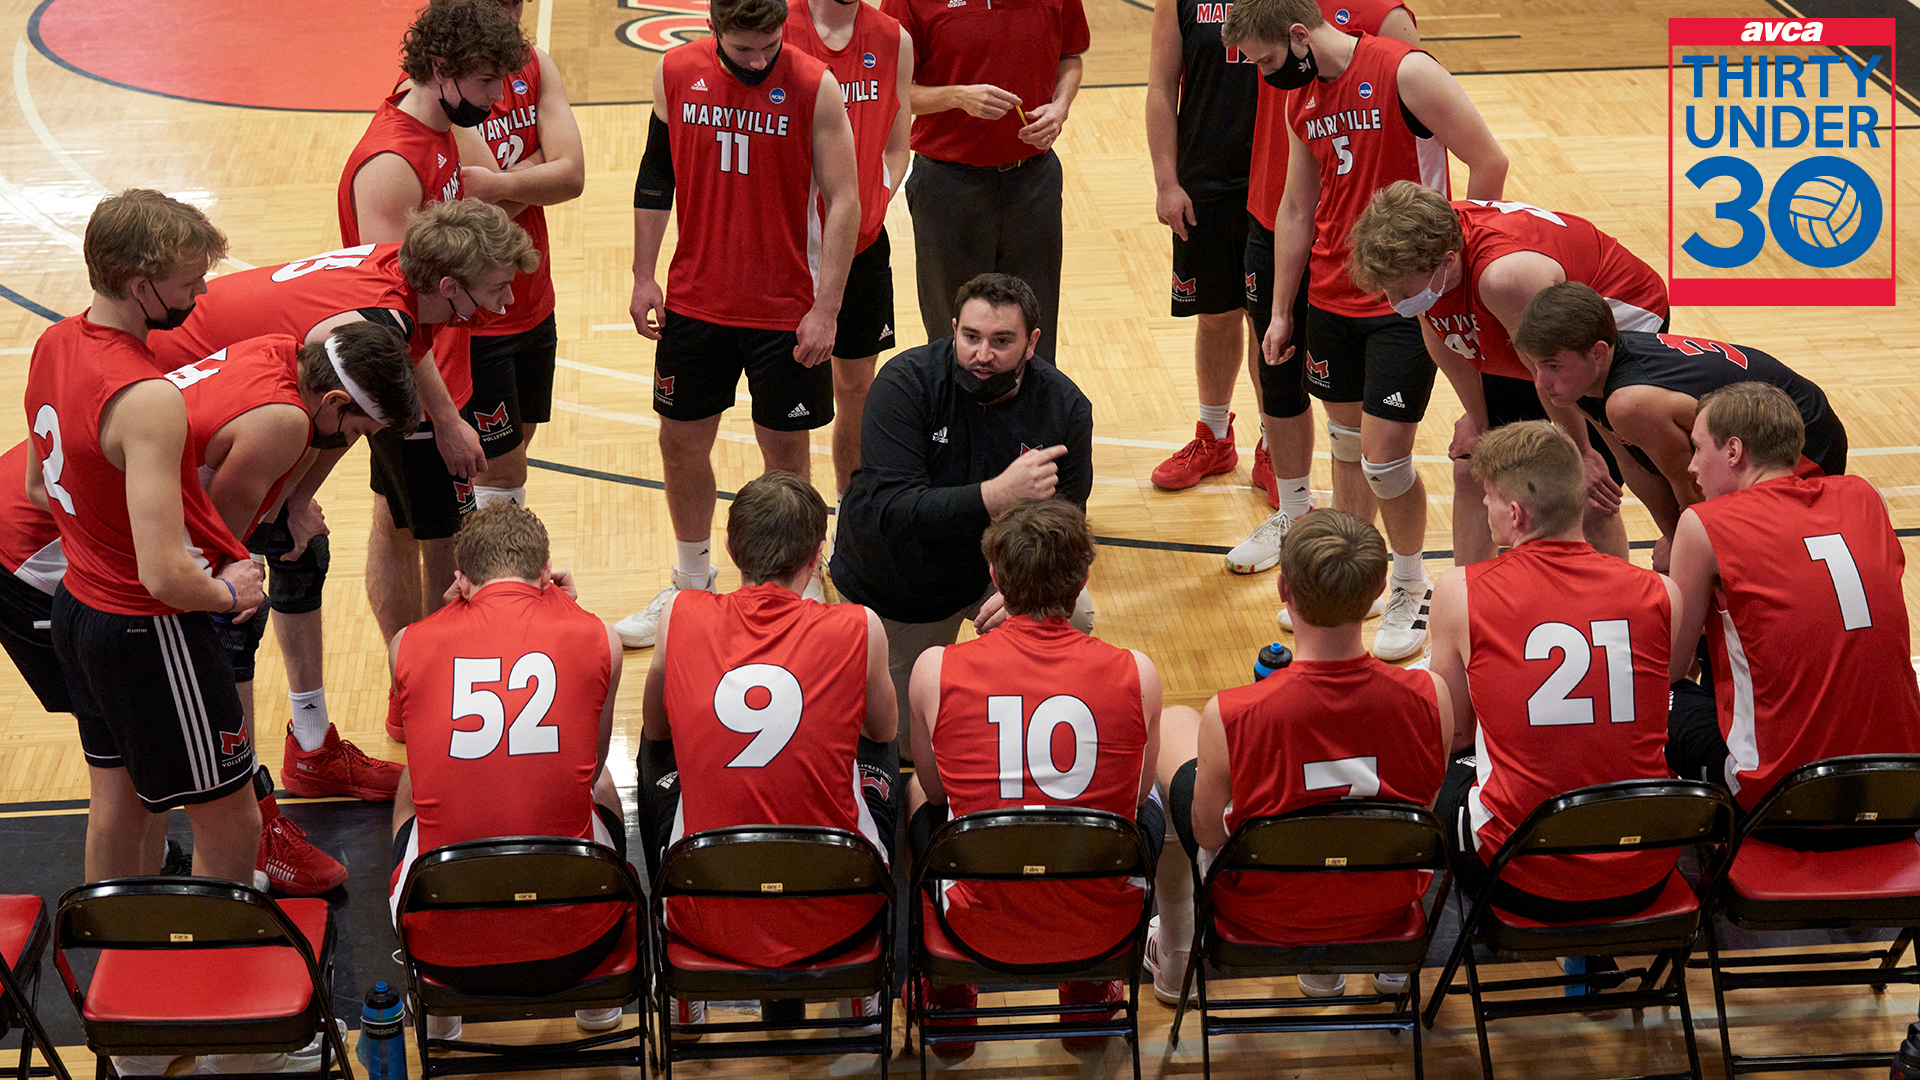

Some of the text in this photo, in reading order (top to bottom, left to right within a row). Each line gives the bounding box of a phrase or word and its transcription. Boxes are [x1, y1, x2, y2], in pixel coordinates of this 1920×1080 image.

[682, 102, 789, 137] MARYVILLE
[715, 129, 750, 175] 11
[1305, 108, 1382, 140] MARYVILLE
[1331, 134, 1354, 176] 5
[33, 402, 77, 517] 2
[482, 428, 514, 442] VOLLEYBALL
[1802, 532, 1874, 632] 1
[449, 650, 561, 761] 52
[1522, 617, 1637, 729] 21
[712, 662, 805, 769] 9
[986, 693, 1100, 801] 10
[1302, 754, 1381, 797] 7
